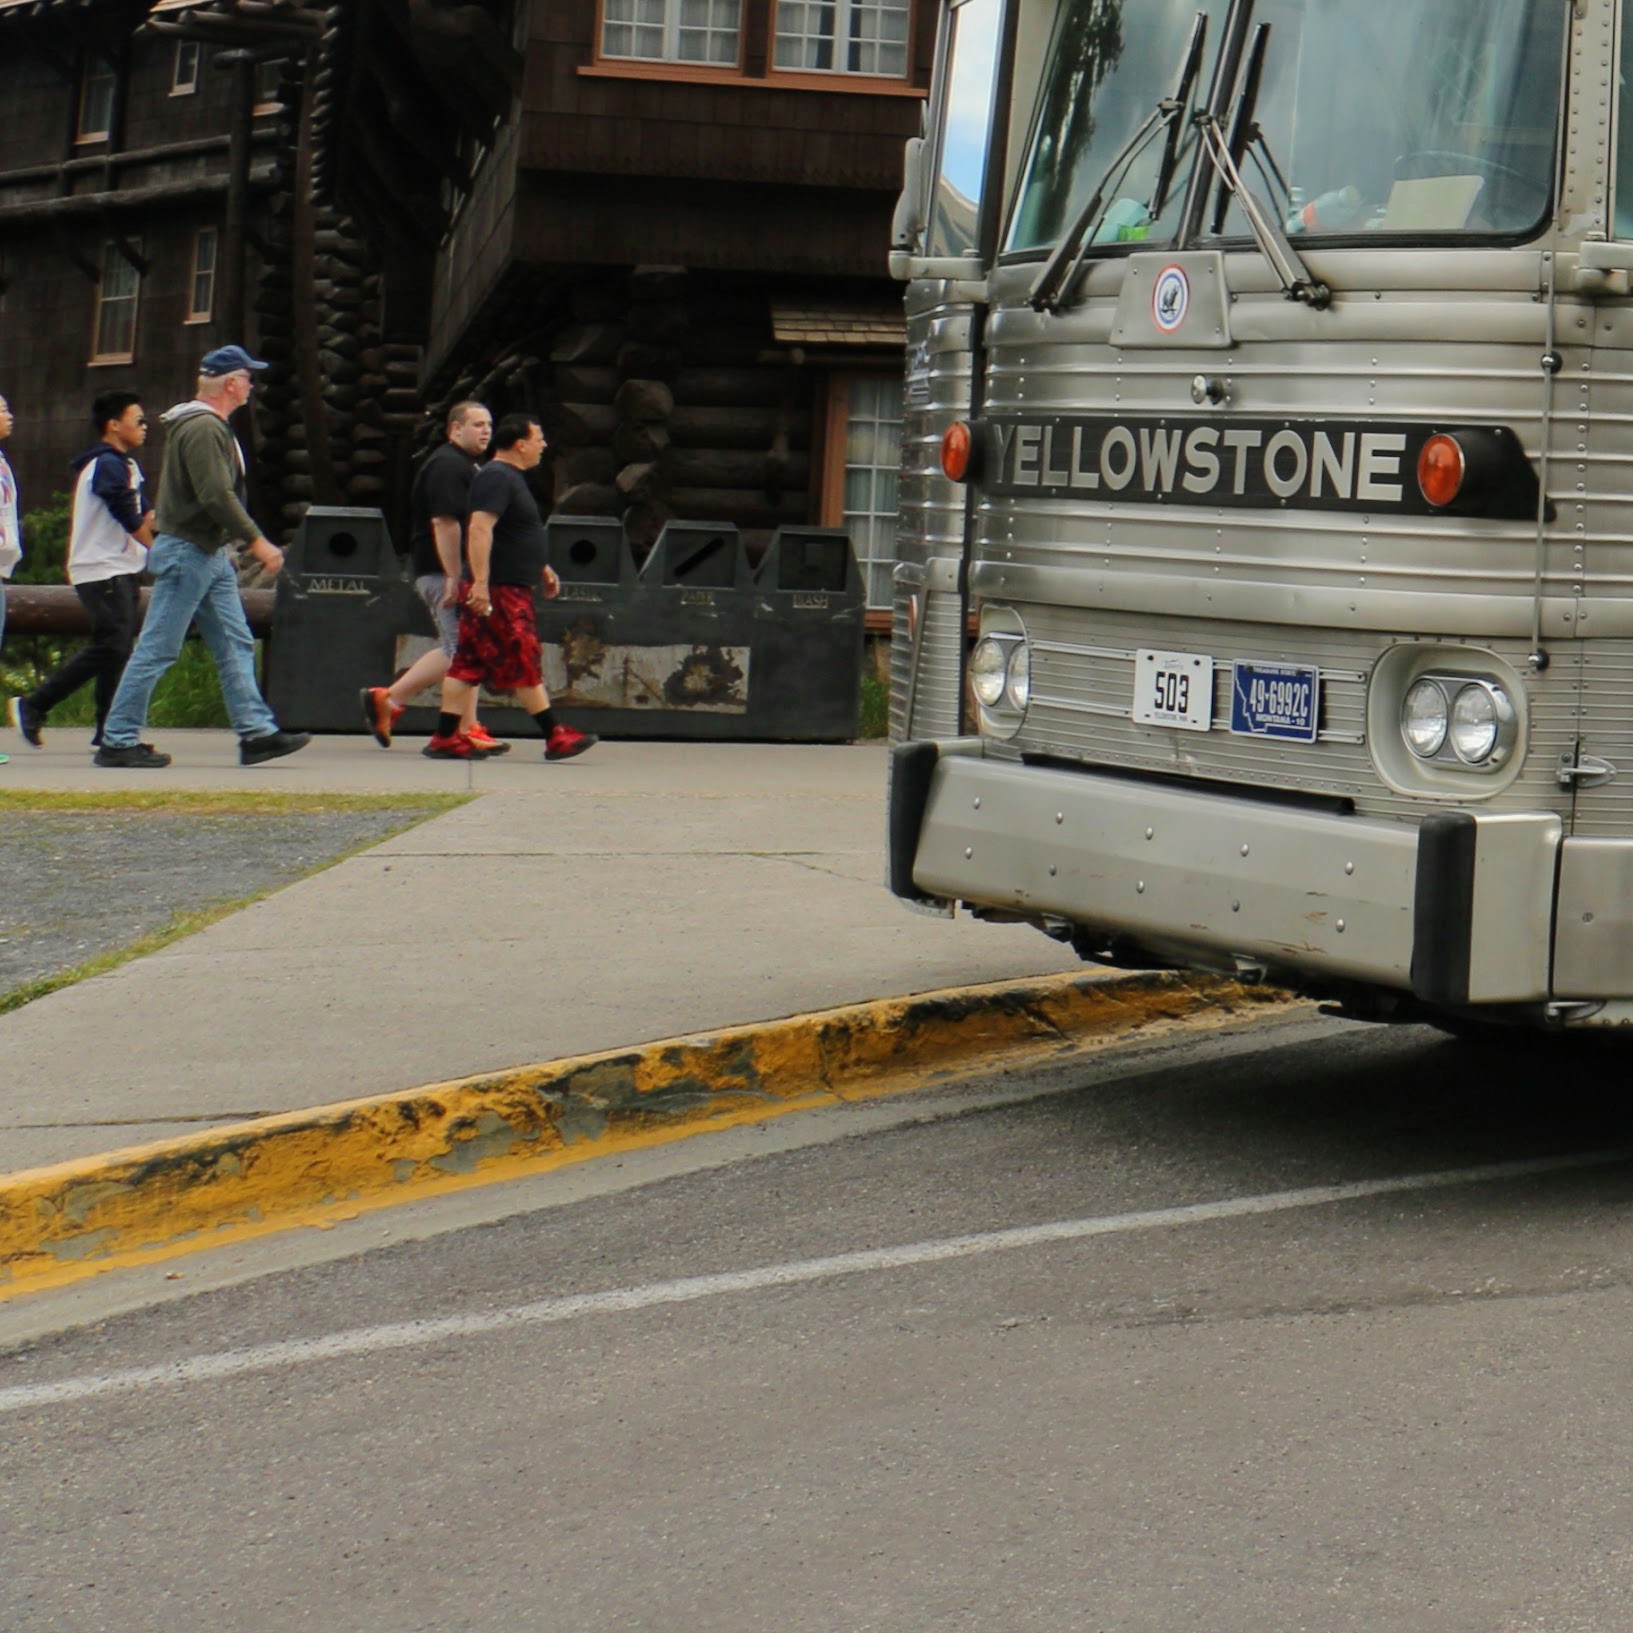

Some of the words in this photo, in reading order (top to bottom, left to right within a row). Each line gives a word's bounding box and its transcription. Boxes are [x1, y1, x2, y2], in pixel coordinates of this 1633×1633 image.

[993, 424, 1407, 502] YELLOWSTONE
[309, 578, 368, 593] METAL
[1154, 670, 1189, 714] 503
